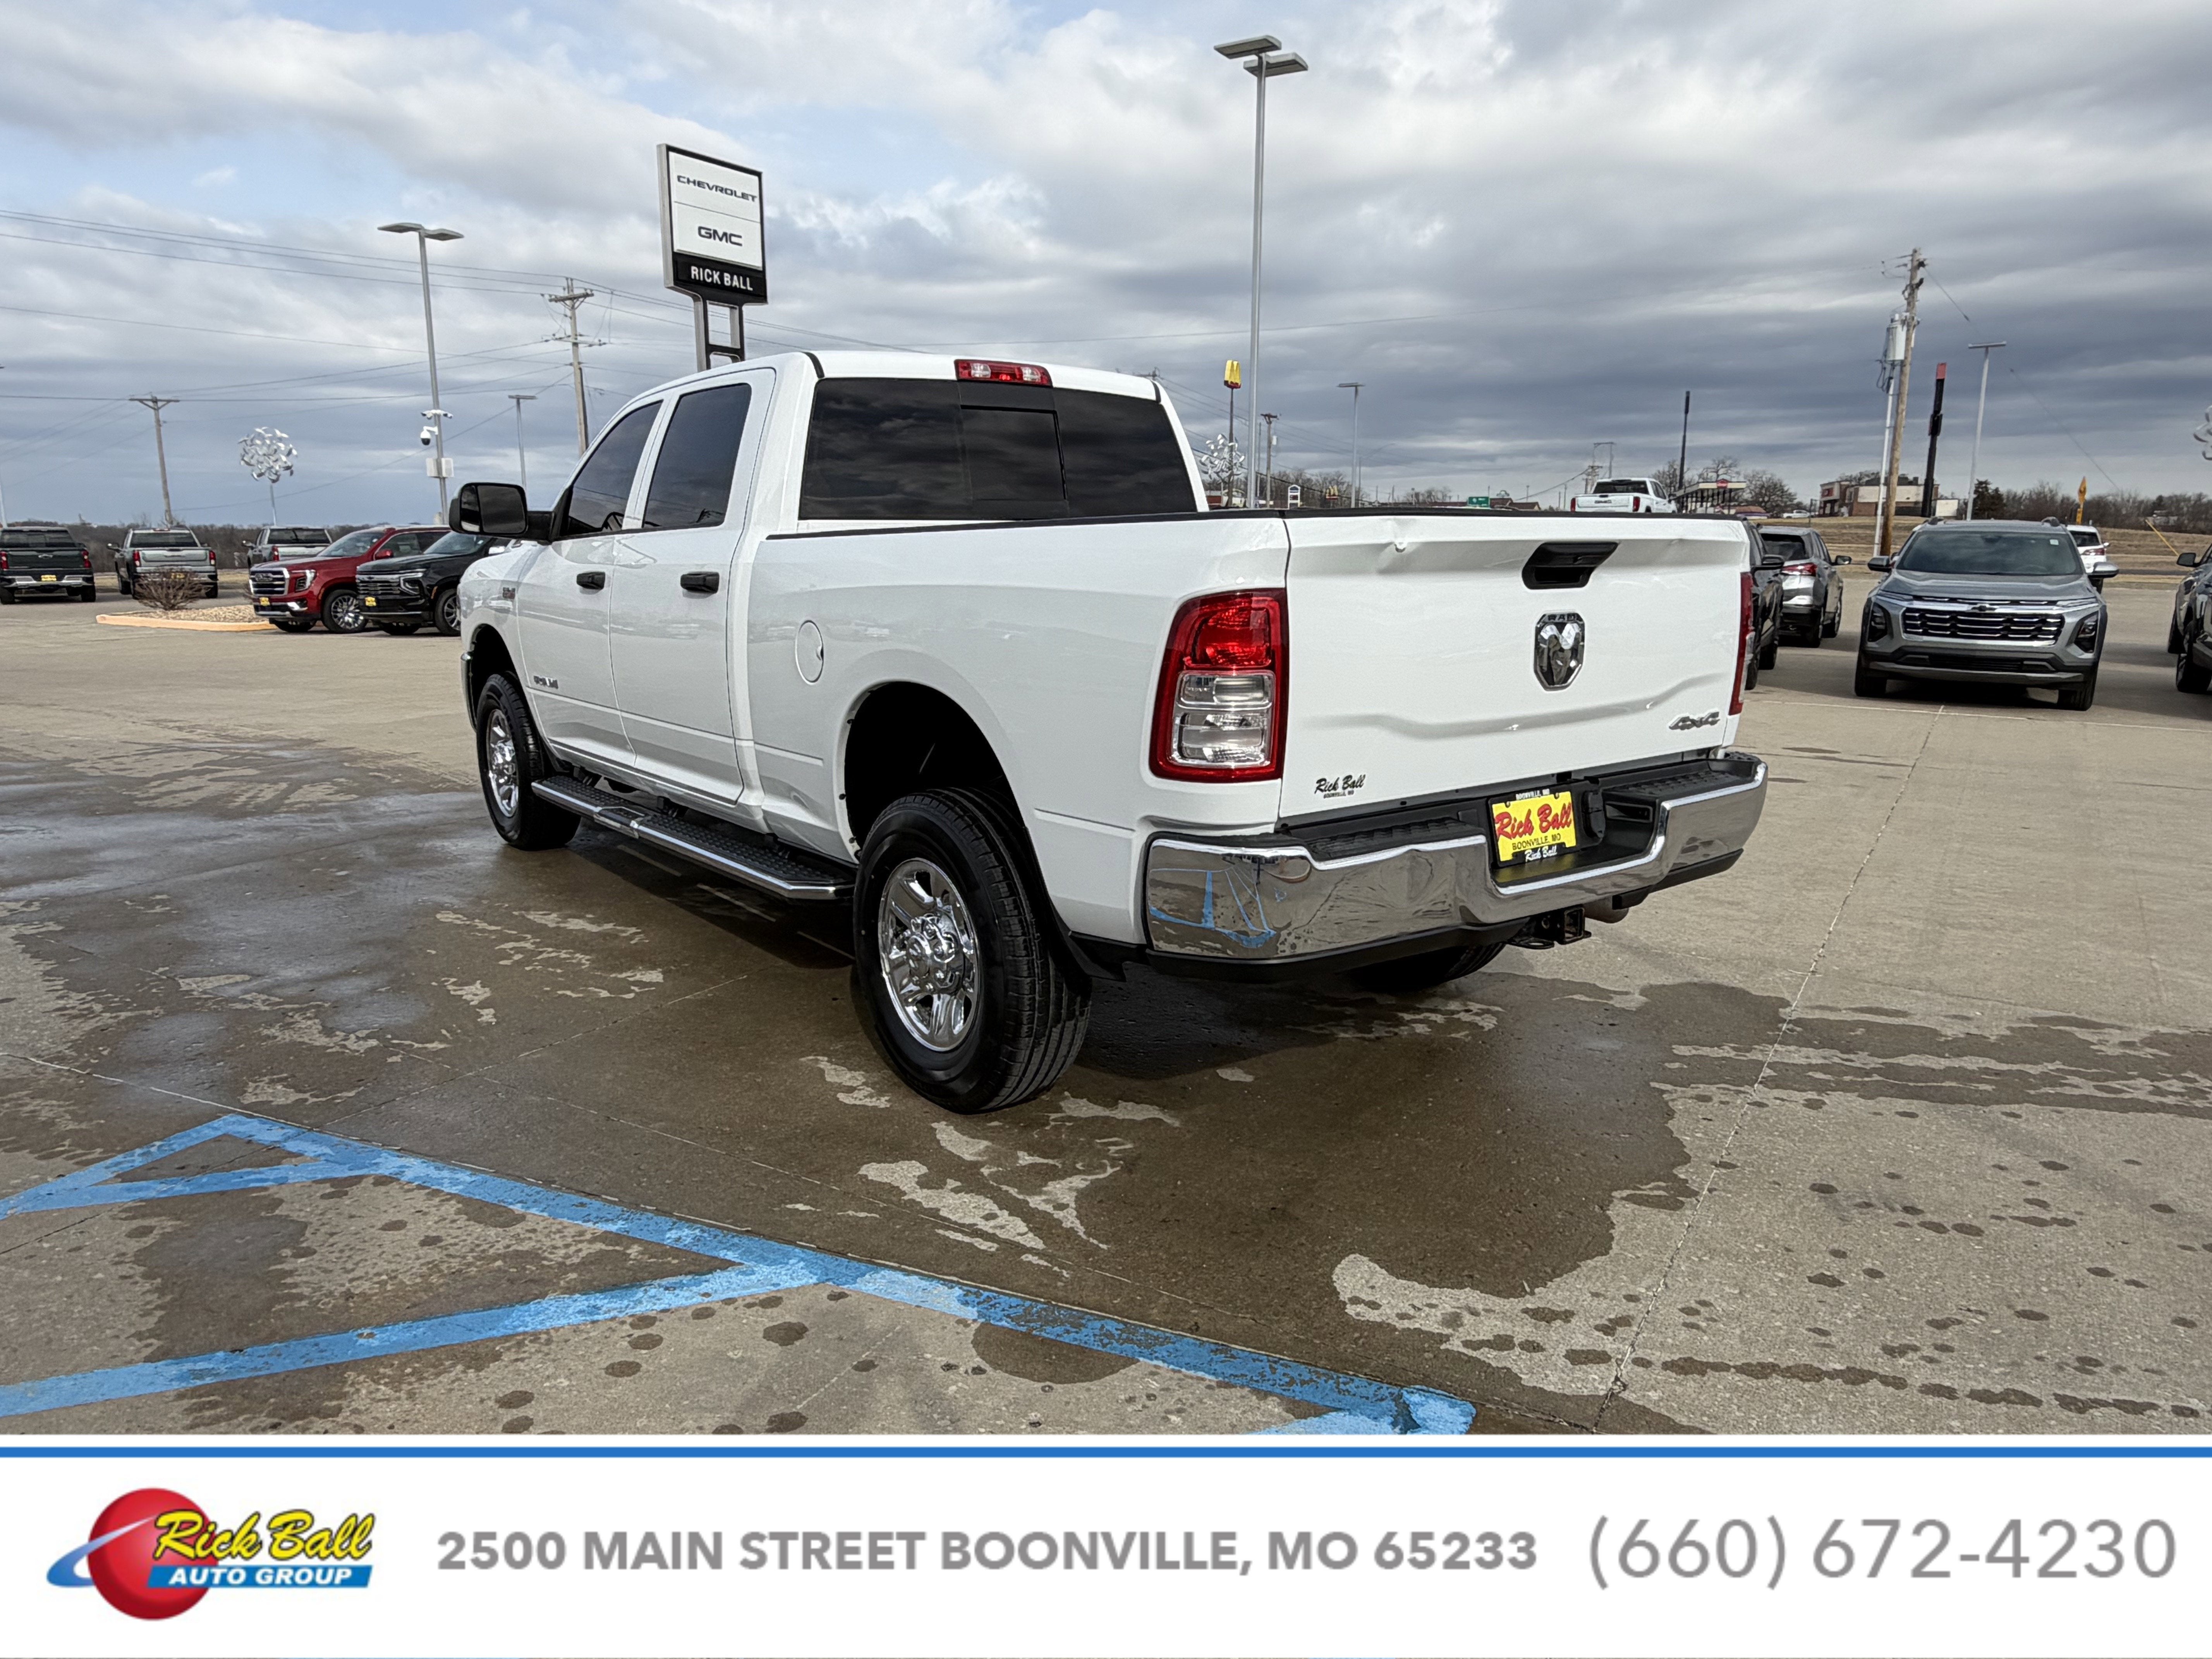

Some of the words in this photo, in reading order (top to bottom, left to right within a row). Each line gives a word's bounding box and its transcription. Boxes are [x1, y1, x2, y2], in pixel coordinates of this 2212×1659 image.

[677, 175, 757, 203] CHEVROLET
[697, 226, 742, 246] GMC
[690, 265, 721, 285] RICK
[723, 274, 753, 291] BALL
[1314, 777, 1340, 794] Rick
[1341, 774, 1366, 790] Ball
[1494, 808, 1534, 841] Rick
[1537, 802, 1572, 833] Ball
[1551, 833, 1561, 842] MO
[1524, 847, 1542, 862] Rick
[1542, 845, 1558, 858] Ball
